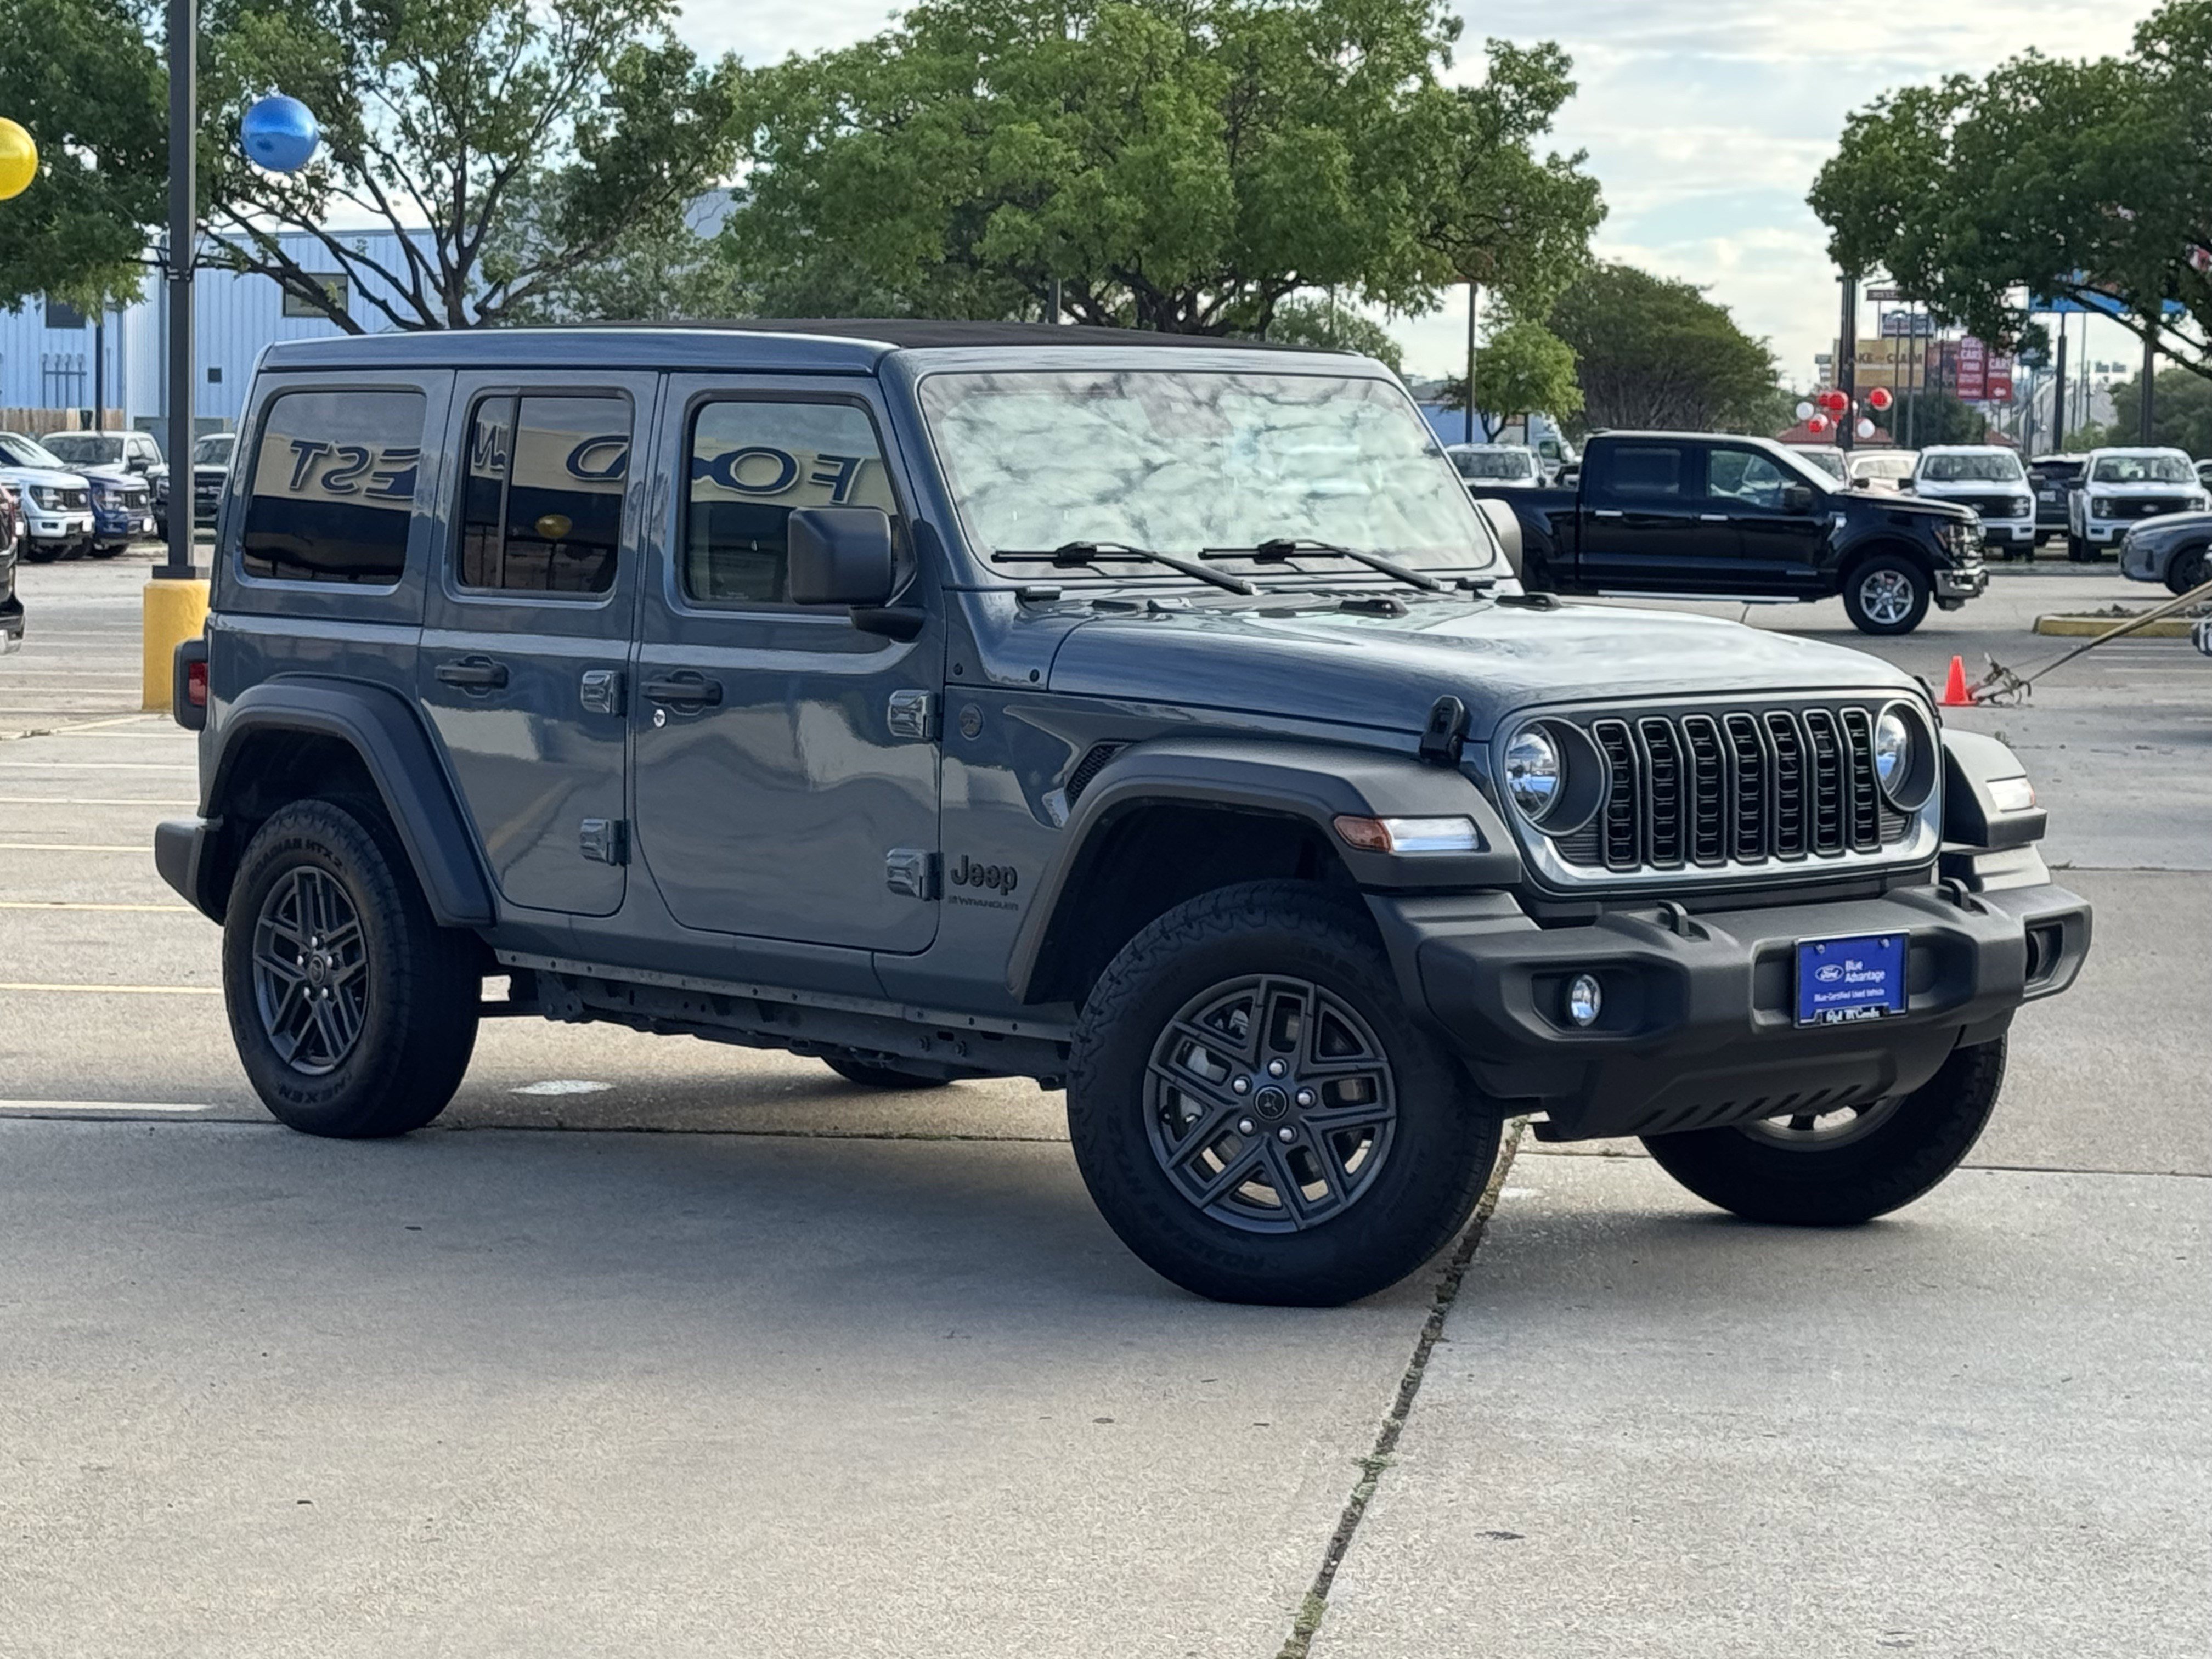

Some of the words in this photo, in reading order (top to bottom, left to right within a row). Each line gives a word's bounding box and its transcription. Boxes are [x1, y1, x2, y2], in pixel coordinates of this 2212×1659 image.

[951, 855, 1018, 896] Jeep
[957, 895, 1019, 911] WRANGLER
[1845, 960, 1863, 971] Blue
[1844, 970, 1886, 983] Advantage
